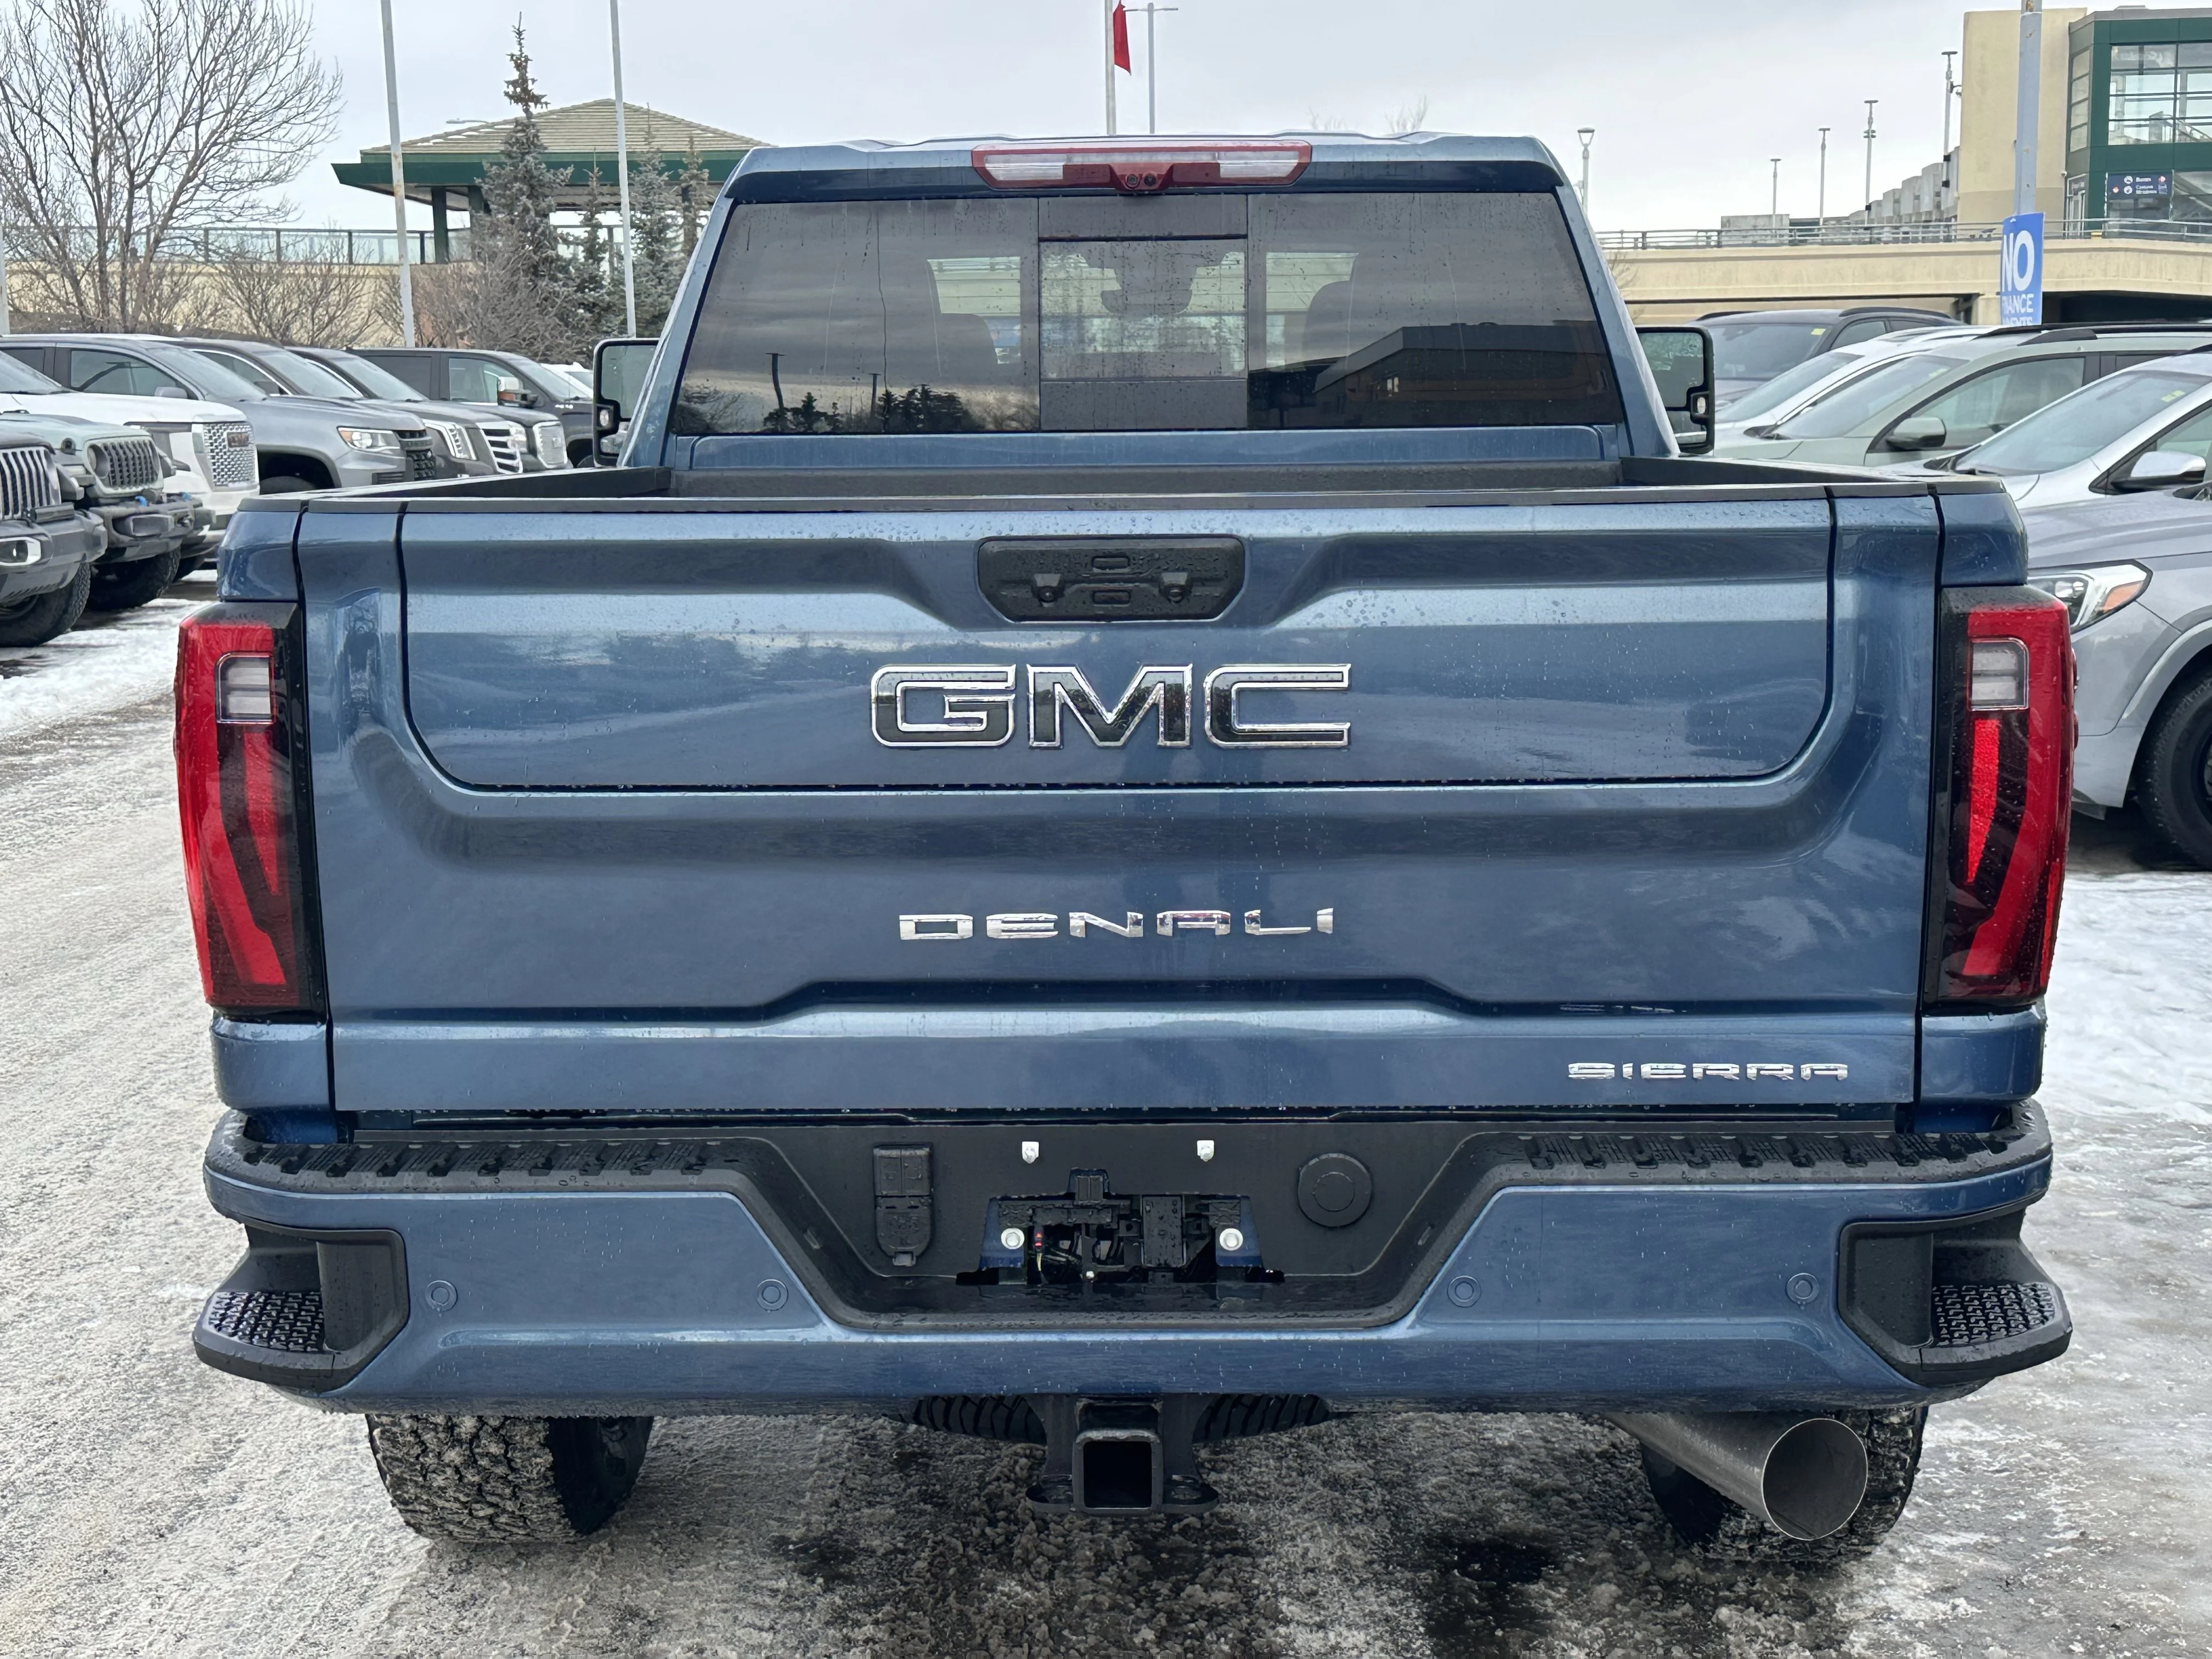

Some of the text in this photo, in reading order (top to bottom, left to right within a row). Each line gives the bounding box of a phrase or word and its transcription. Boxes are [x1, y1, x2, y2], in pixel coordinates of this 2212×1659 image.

[2002, 230, 2034, 292] NO
[871, 663, 1351, 749] GMC
[900, 908, 1334, 940] DENALI
[1568, 1063, 1848, 1080] SIERRA
